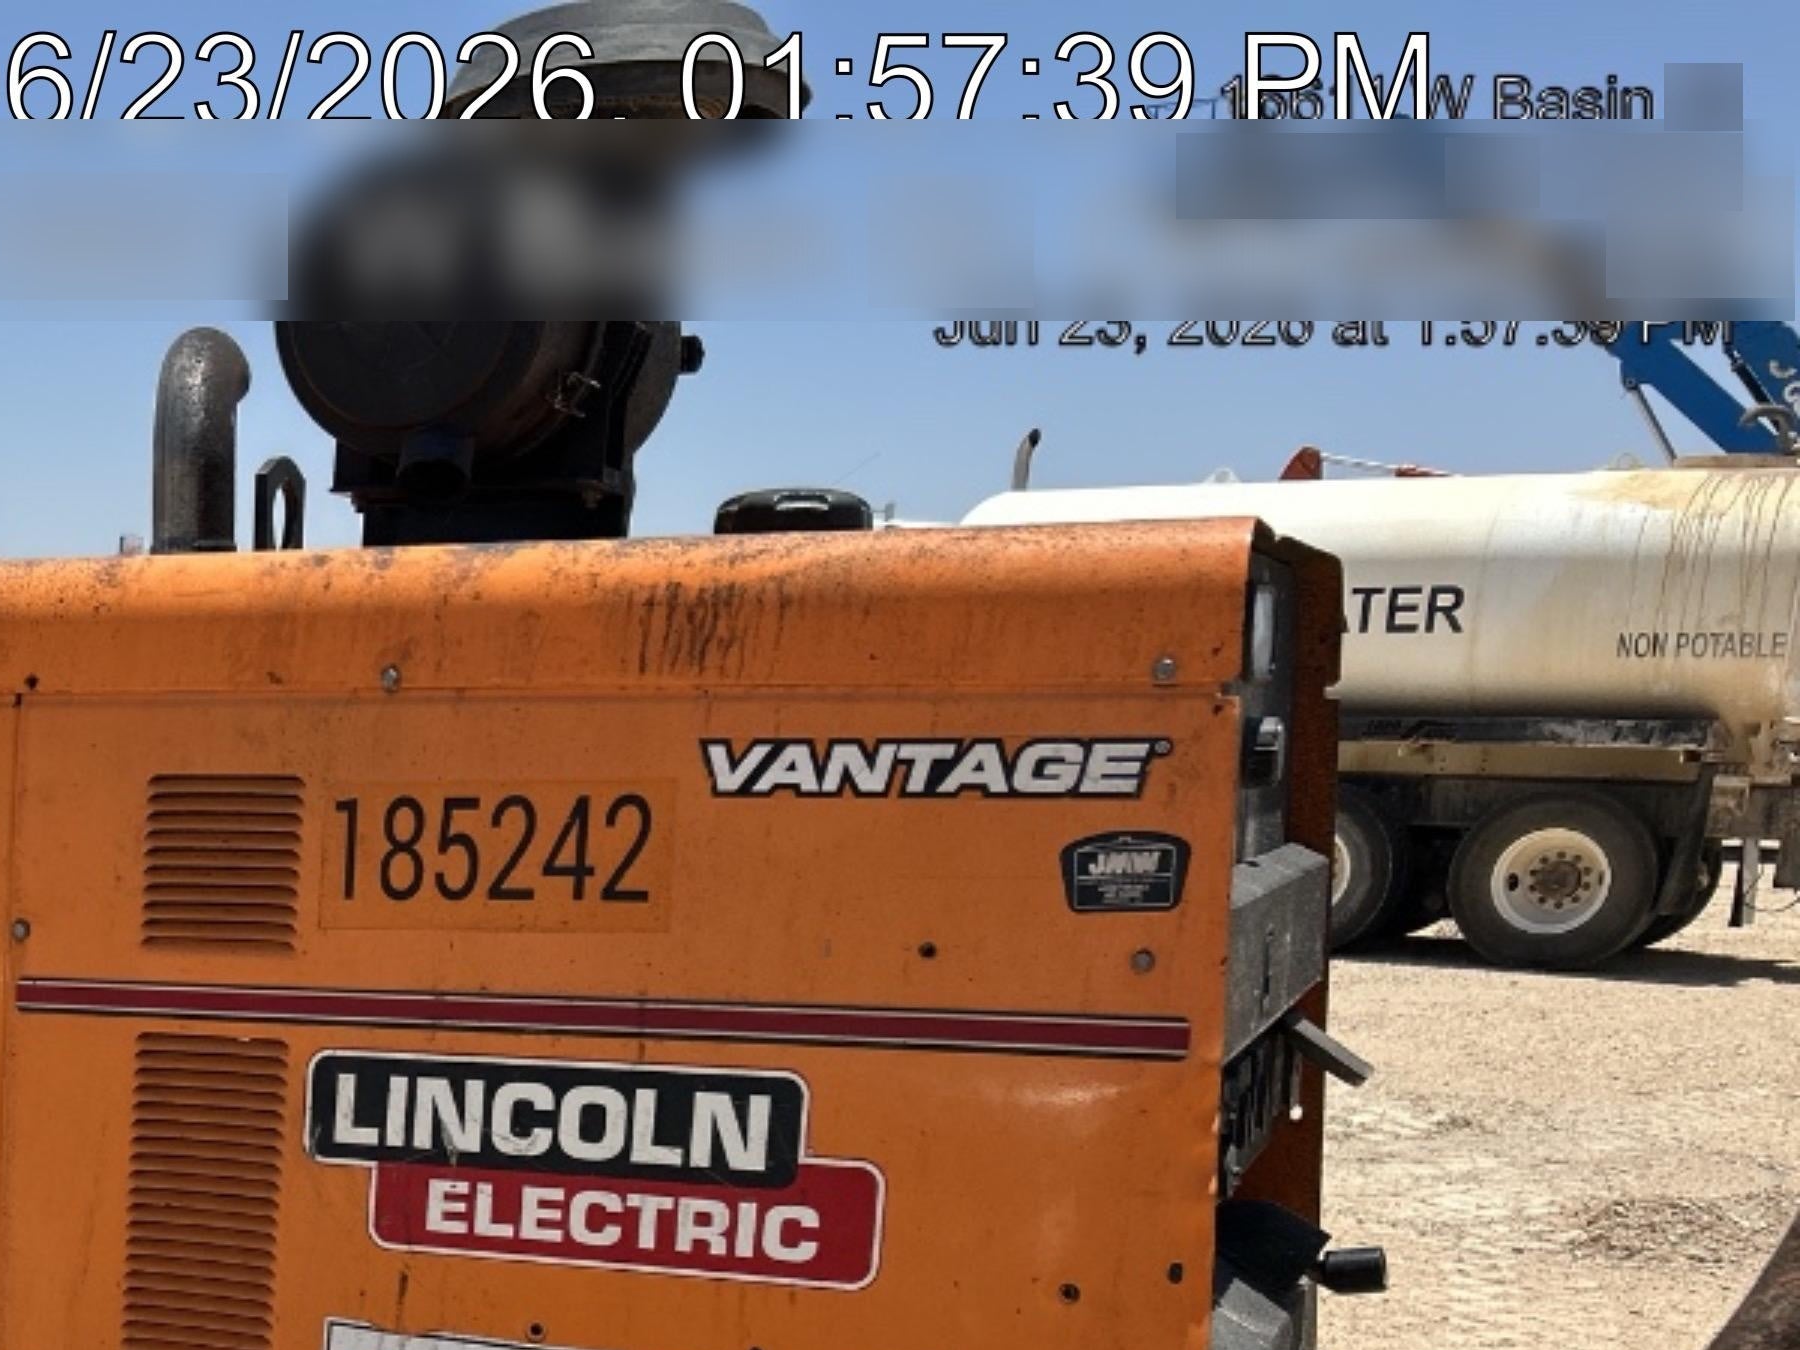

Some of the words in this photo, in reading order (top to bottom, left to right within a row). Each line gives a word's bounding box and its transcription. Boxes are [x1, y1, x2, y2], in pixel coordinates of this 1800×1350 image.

[1341, 584, 1465, 633] TER
[1616, 631, 1669, 659] NON
[1675, 631, 1789, 659] POTABLE
[704, 741, 1151, 795] VANTAGE
[335, 793, 652, 903] 185242
[332, 1072, 772, 1172] LINCOLN
[424, 1177, 821, 1264] ELECTRIC
